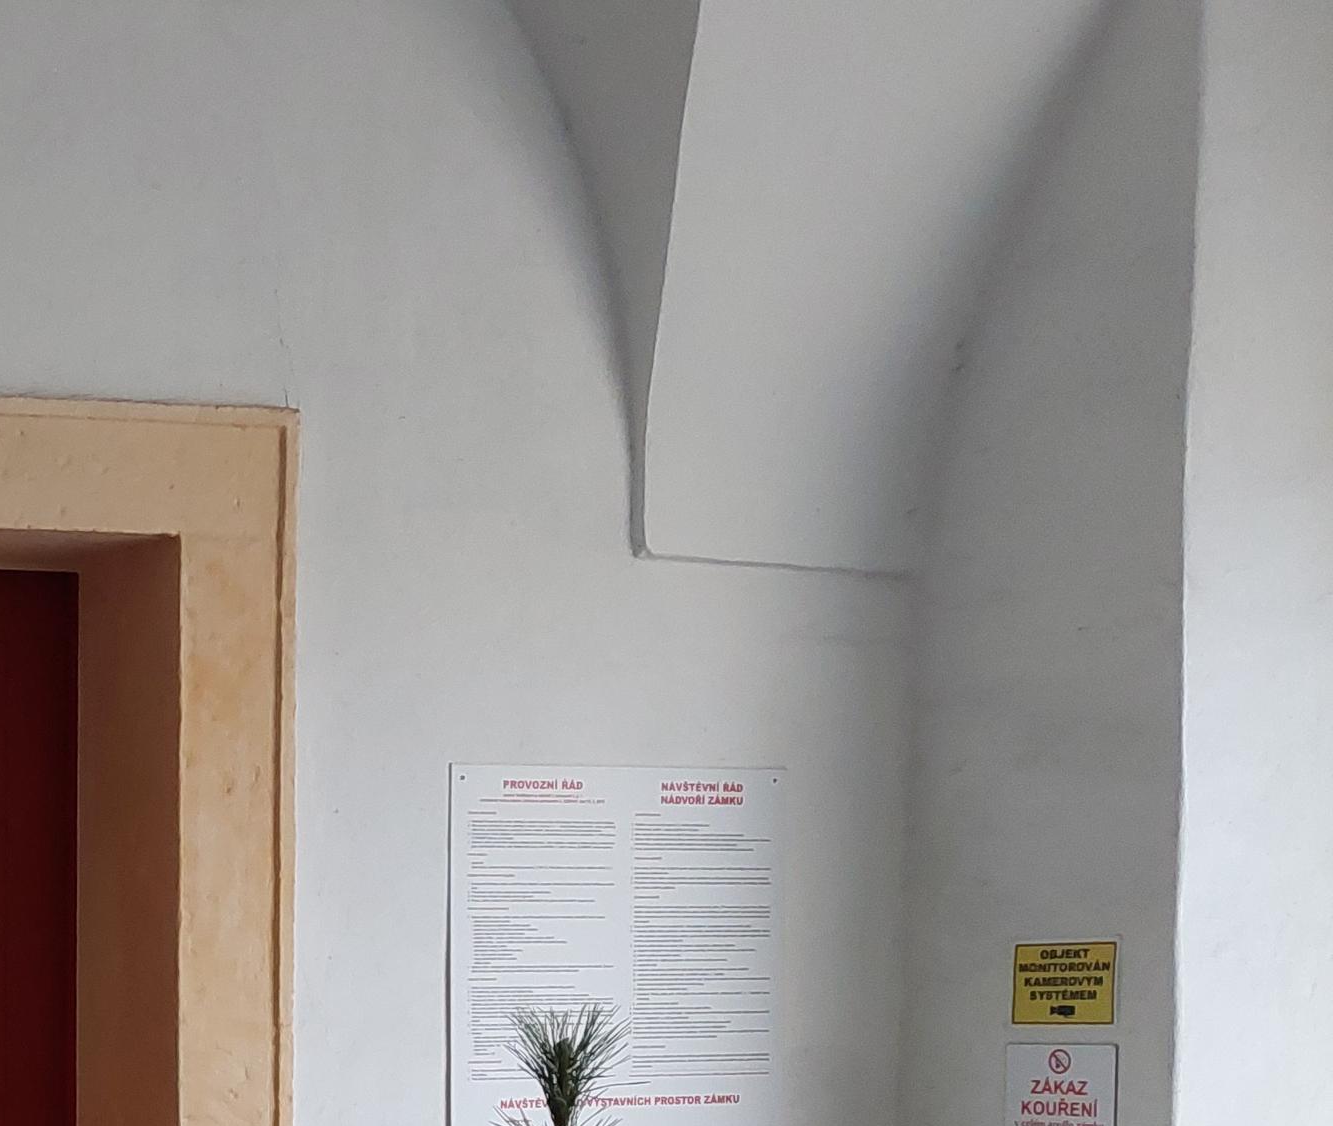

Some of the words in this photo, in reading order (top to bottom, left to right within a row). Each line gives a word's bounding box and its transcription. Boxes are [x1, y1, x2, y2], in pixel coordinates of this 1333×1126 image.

[502, 779, 558, 791] PROVOZNÍ
[561, 778, 584, 791] ŘÁD
[722, 781, 744, 794] ŘÁD
[708, 794, 744, 807] ZÁMKU
[1039, 948, 1091, 960] OBJEKT
[1018, 960, 1111, 974] MONITOROVÁN
[1029, 988, 1098, 1001] SYSTÉMEM
[1030, 1078, 1089, 1096] ZÁKAZ
[654, 1095, 702, 1106] PROSTOR
[704, 1093, 740, 1106] ZÁMKU
[1021, 1098, 1098, 1118] KOUŘENÍ
